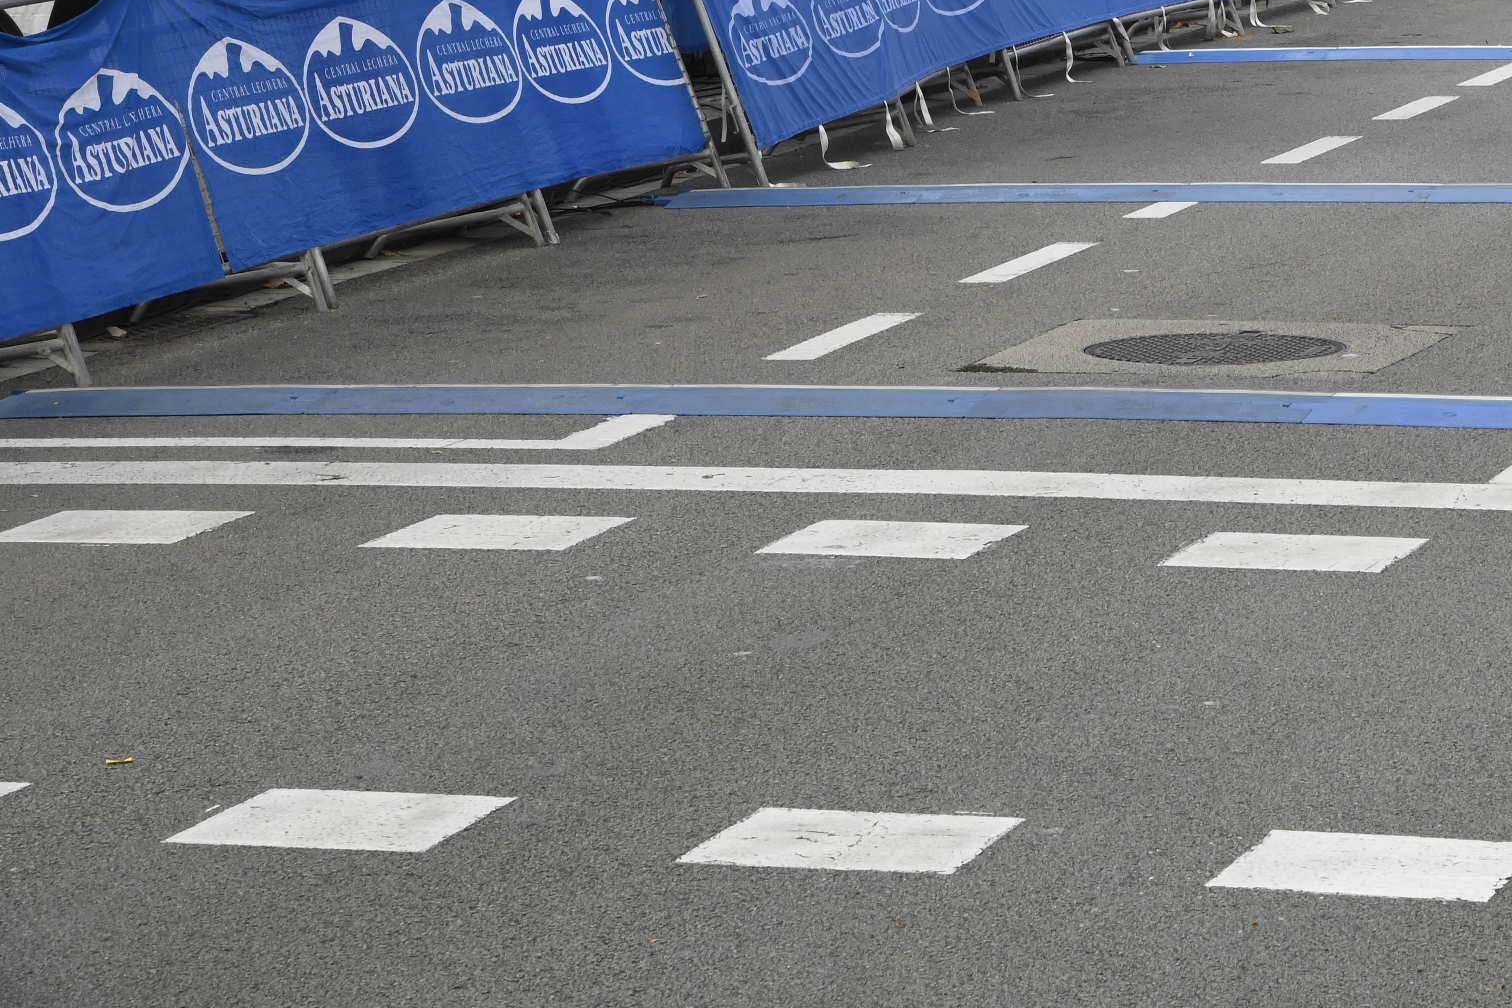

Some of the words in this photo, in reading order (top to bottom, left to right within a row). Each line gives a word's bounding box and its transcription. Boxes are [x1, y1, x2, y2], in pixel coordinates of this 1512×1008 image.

[522, 33, 607, 79] ASTURIANA
[530, 26, 559, 41] CENTRAL
[211, 84, 249, 102] CENTRAL
[251, 78, 289, 96] LECHERA
[324, 62, 360, 80] CENTRAL
[362, 54, 399, 72] LECHERA
[426, 49, 518, 96] ASTURIANA
[314, 71, 414, 122] ASTURIANA
[200, 95, 304, 148] ASTURIANA
